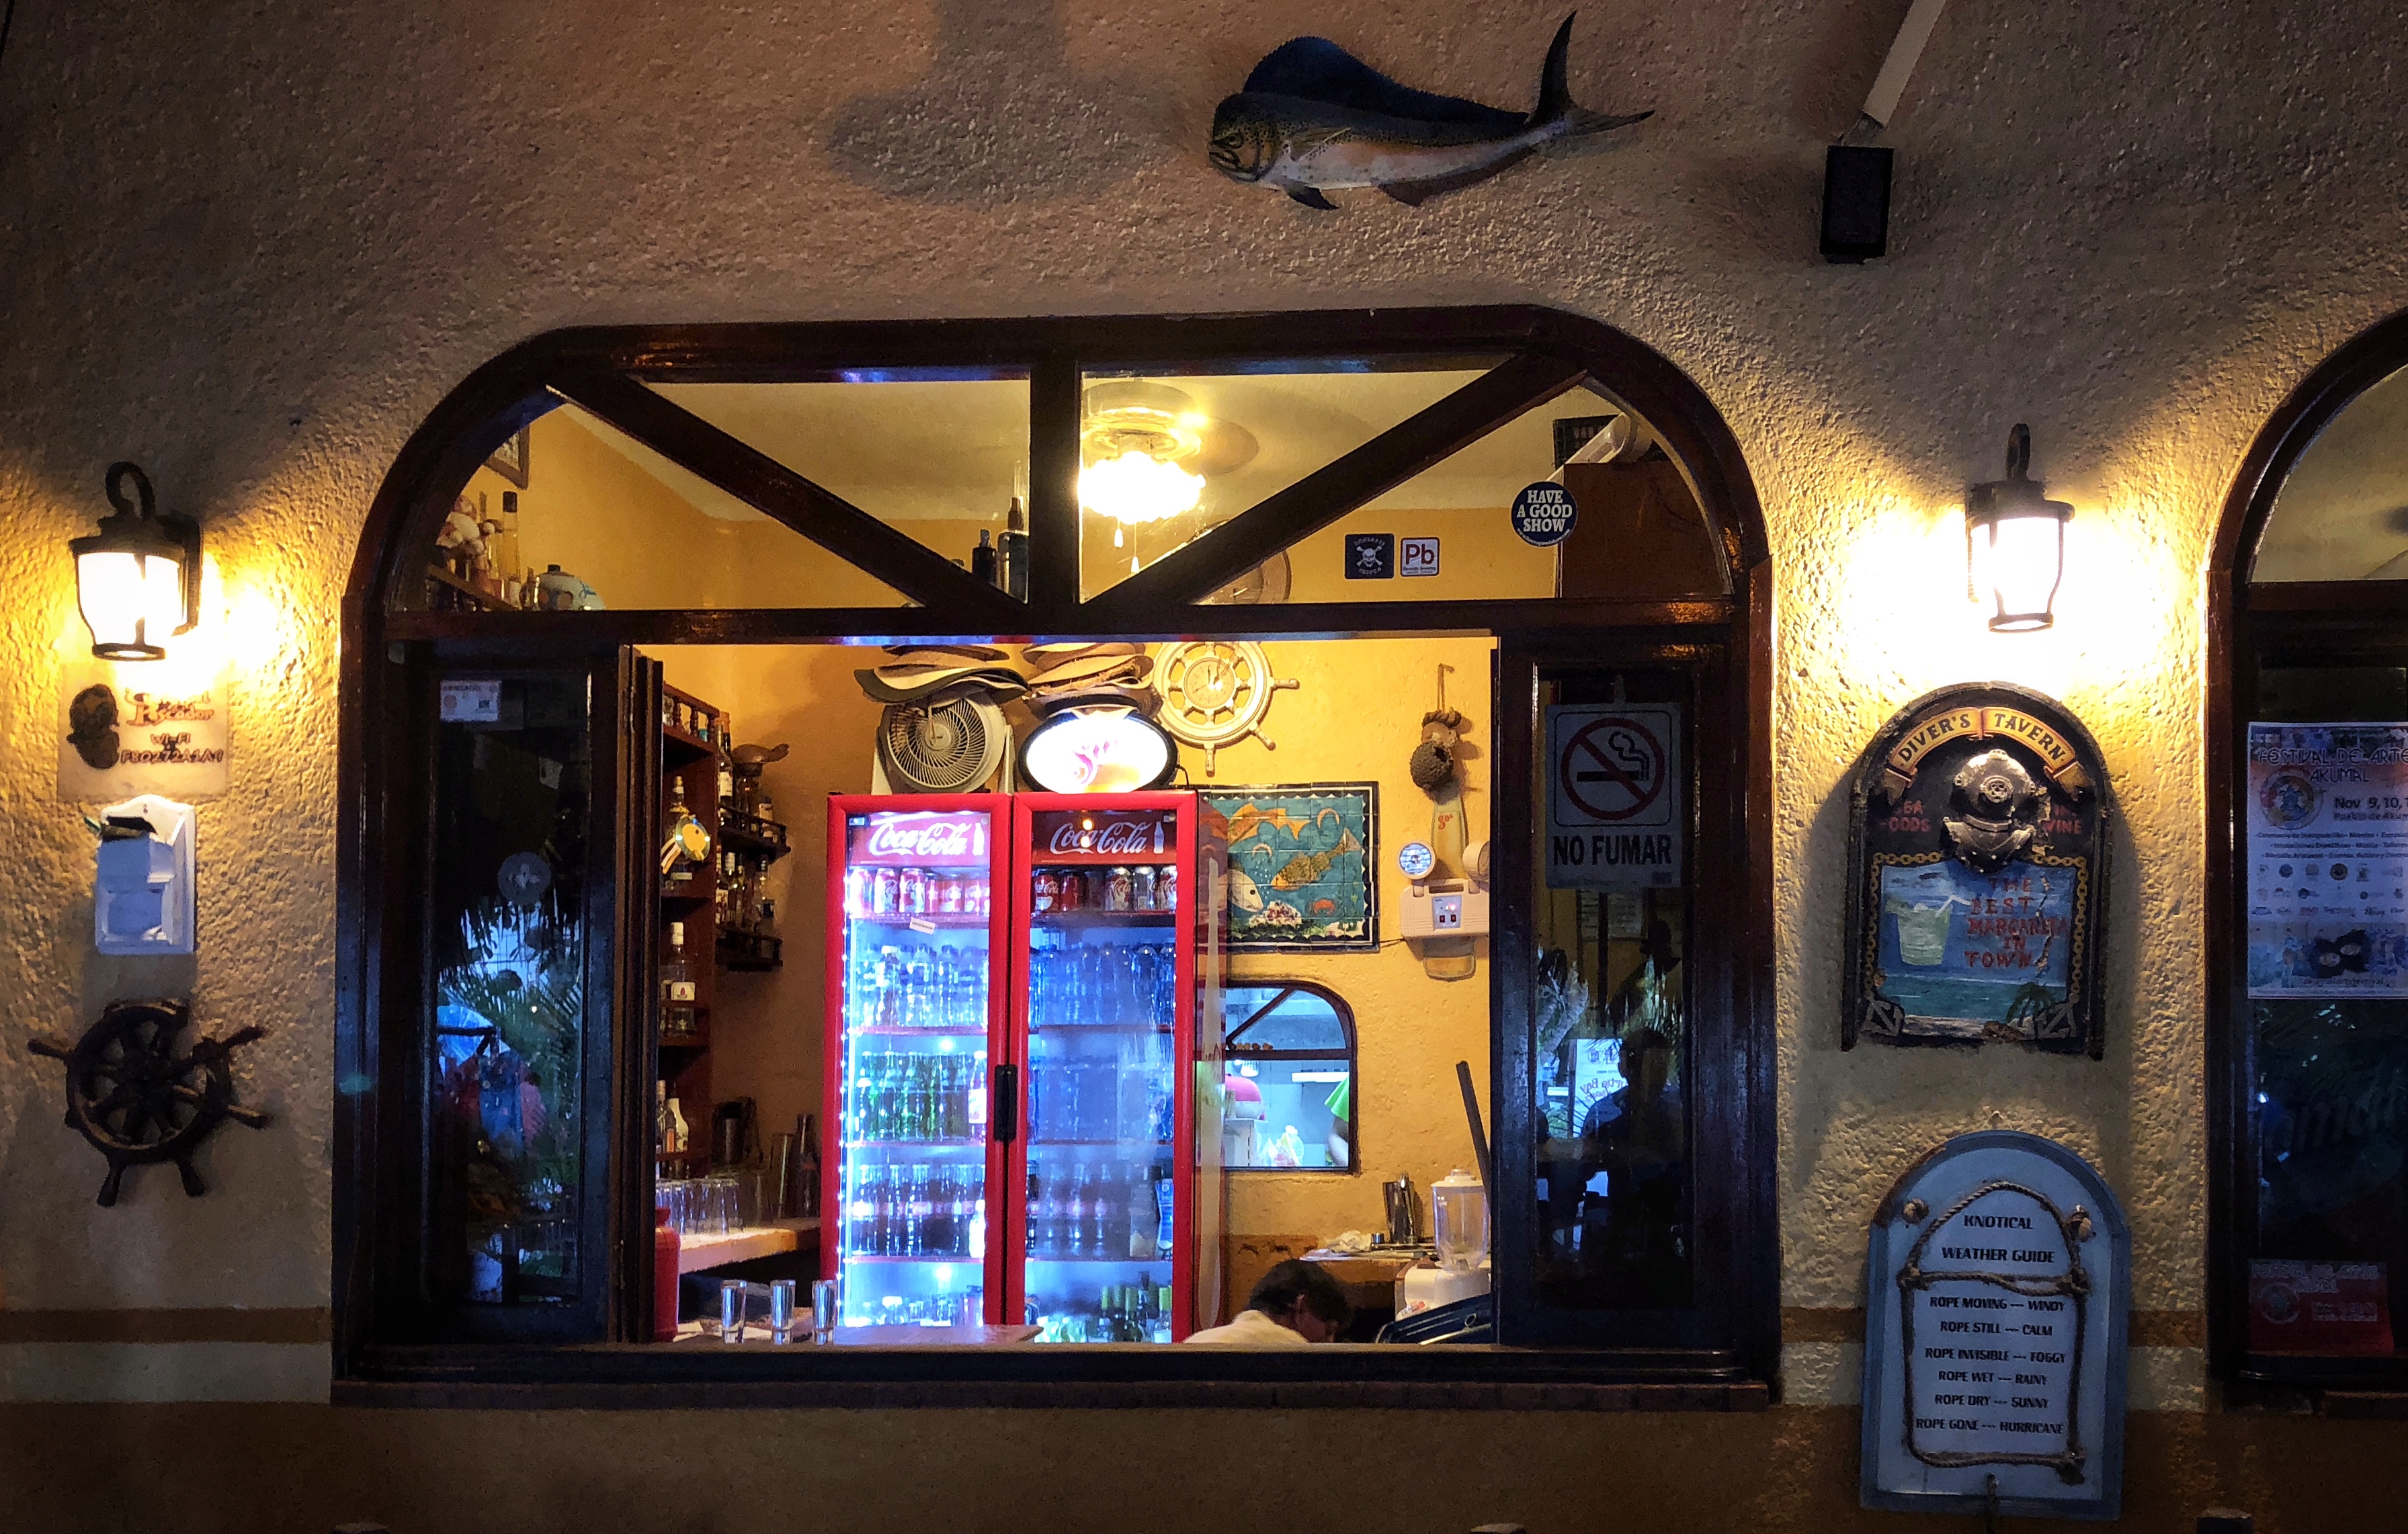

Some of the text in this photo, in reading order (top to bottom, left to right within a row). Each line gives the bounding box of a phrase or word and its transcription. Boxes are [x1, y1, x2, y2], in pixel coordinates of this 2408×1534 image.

[1527, 490, 1564, 503] HAVE
[1516, 504, 1573, 518] A GOOD
[1523, 518, 1567, 532] SHOW
[1405, 544, 1435, 565] Pb
[1898, 713, 2067, 762] DIVER'S TAVERN
[2259, 748, 2332, 766] FESTIVAL
[2335, 748, 2364, 766] DE
[2309, 767, 2370, 783] AKUMAL
[2334, 796, 2361, 810] Nov
[1050, 822, 1152, 855] Coca-Cola
[1552, 834, 1673, 866] NO FUMAR
[1989, 877, 2032, 893] THE
[1970, 896, 2037, 915] BEST
[1966, 917, 2069, 936] MARGARITA
[2003, 937, 2027, 950] IN
[1964, 951, 2032, 969] TOWN
[1964, 1215, 2034, 1230] KNOTICAL
[1941, 1247, 2055, 1263] WEATHER GUIDE
[1929, 1296, 1959, 1308] ROPE
[1962, 1297, 2007, 1310] MOVING
[2028, 1300, 2065, 1312] WINDY
[1940, 1321, 1970, 1333] ROPE
[1973, 1322, 2001, 1334] STILL
[2022, 1324, 2052, 1336] CALM
[1925, 1347, 1955, 1359] ROPE
[1958, 1349, 2009, 1361] INVISIBLE
[2030, 1351, 2067, 1363] FOGGY
[1938, 1371, 1968, 1382] ROPE
[1971, 1371, 1995, 1383] WET
[2015, 1373, 2048, 1386] RAINY
[1935, 1394, 1964, 1406] ROPE
[1968, 1395, 1991, 1406] DRY
[2011, 1396, 2049, 1408] SUNNY
[1916, 1418, 1946, 1429] ROPE
[1949, 1418, 1979, 1431] GONE
[1999, 1421, 2064, 1435] HURRICANE
